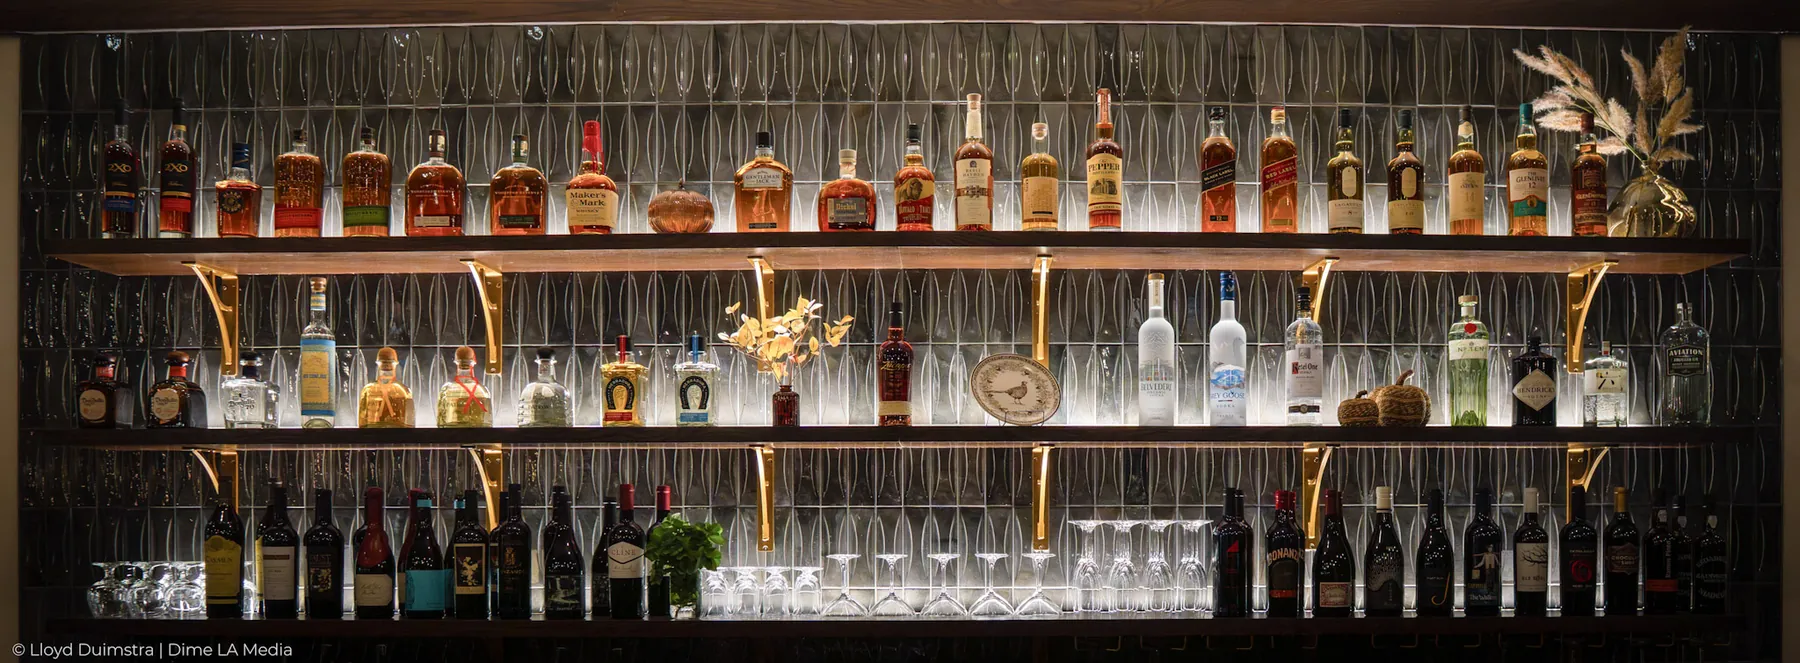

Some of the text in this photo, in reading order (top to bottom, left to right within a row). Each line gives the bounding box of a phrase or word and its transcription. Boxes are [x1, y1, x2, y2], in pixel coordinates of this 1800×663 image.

[108, 162, 132, 173] 2XO
[165, 162, 188, 173] 2XO
[1088, 163, 1120, 172] PEPPER
[1265, 165, 1297, 180] RED LABEL
[570, 191, 606, 199] Maker's
[579, 199, 606, 207] Mark
[1669, 348, 1704, 357] AVIATION
[1292, 362, 1318, 375] Ketel One
[1140, 382, 1173, 392] BELVEDERE
[611, 547, 636, 556] CLINE
[1266, 546, 1299, 568] BONANZ
[1431, 571, 1451, 606] J
